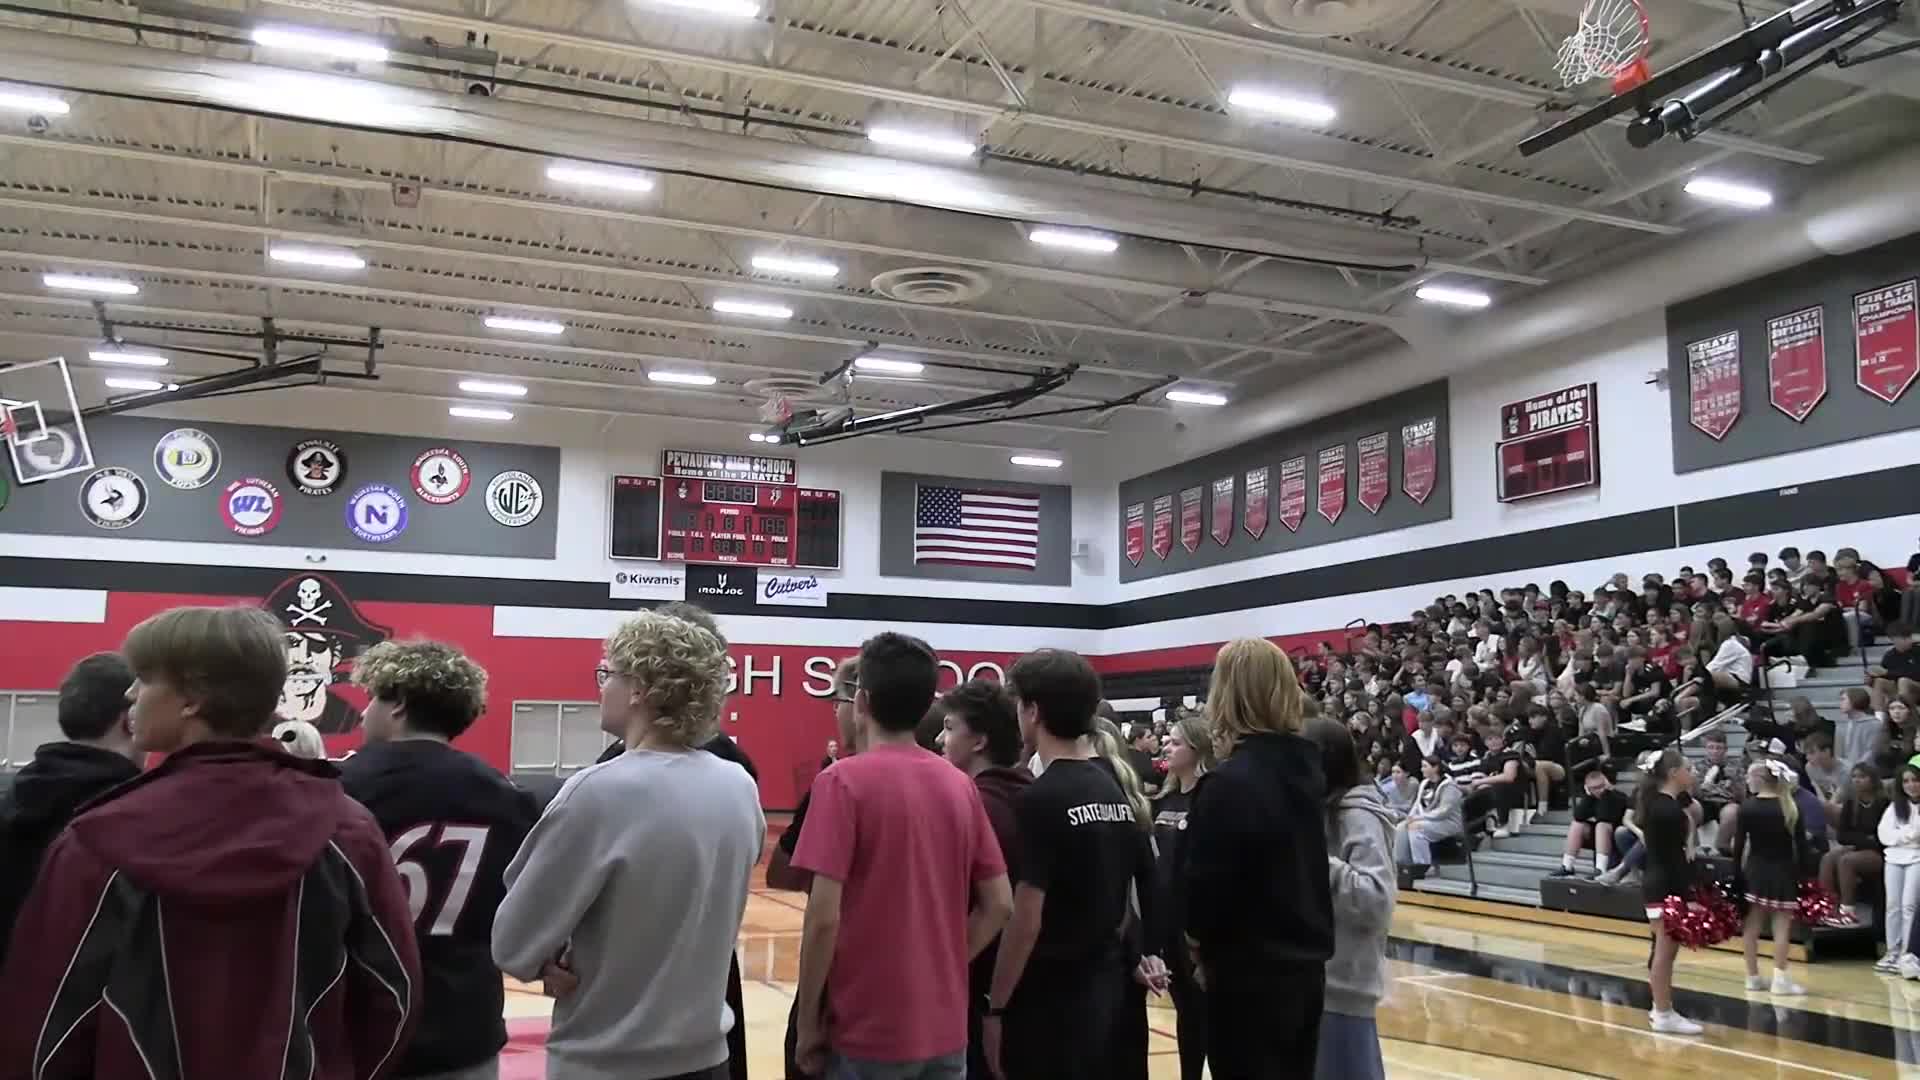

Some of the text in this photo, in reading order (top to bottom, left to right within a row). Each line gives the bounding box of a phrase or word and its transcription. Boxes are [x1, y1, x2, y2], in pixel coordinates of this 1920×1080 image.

[1858, 285, 1913, 305] PIRATE
[1884, 292, 1913, 309] TRACK
[1860, 305, 1913, 323] CHAMPIONS
[1525, 388, 1587, 413] Home of the
[1529, 402, 1584, 431] PIRATES
[452, 453, 469, 474] SOUTH
[666, 450, 792, 475] PEWAUKEE HIGH SCHOOL
[674, 467, 786, 482] Home of the PIRATES
[298, 484, 333, 495] PIRATES
[231, 494, 272, 516] WL
[710, 532, 732, 541] PLAYER
[629, 574, 680, 586] Kiwanis
[764, 575, 819, 598] Culver's
[1067, 803, 1100, 826] STATE
[388, 823, 490, 937] 67
